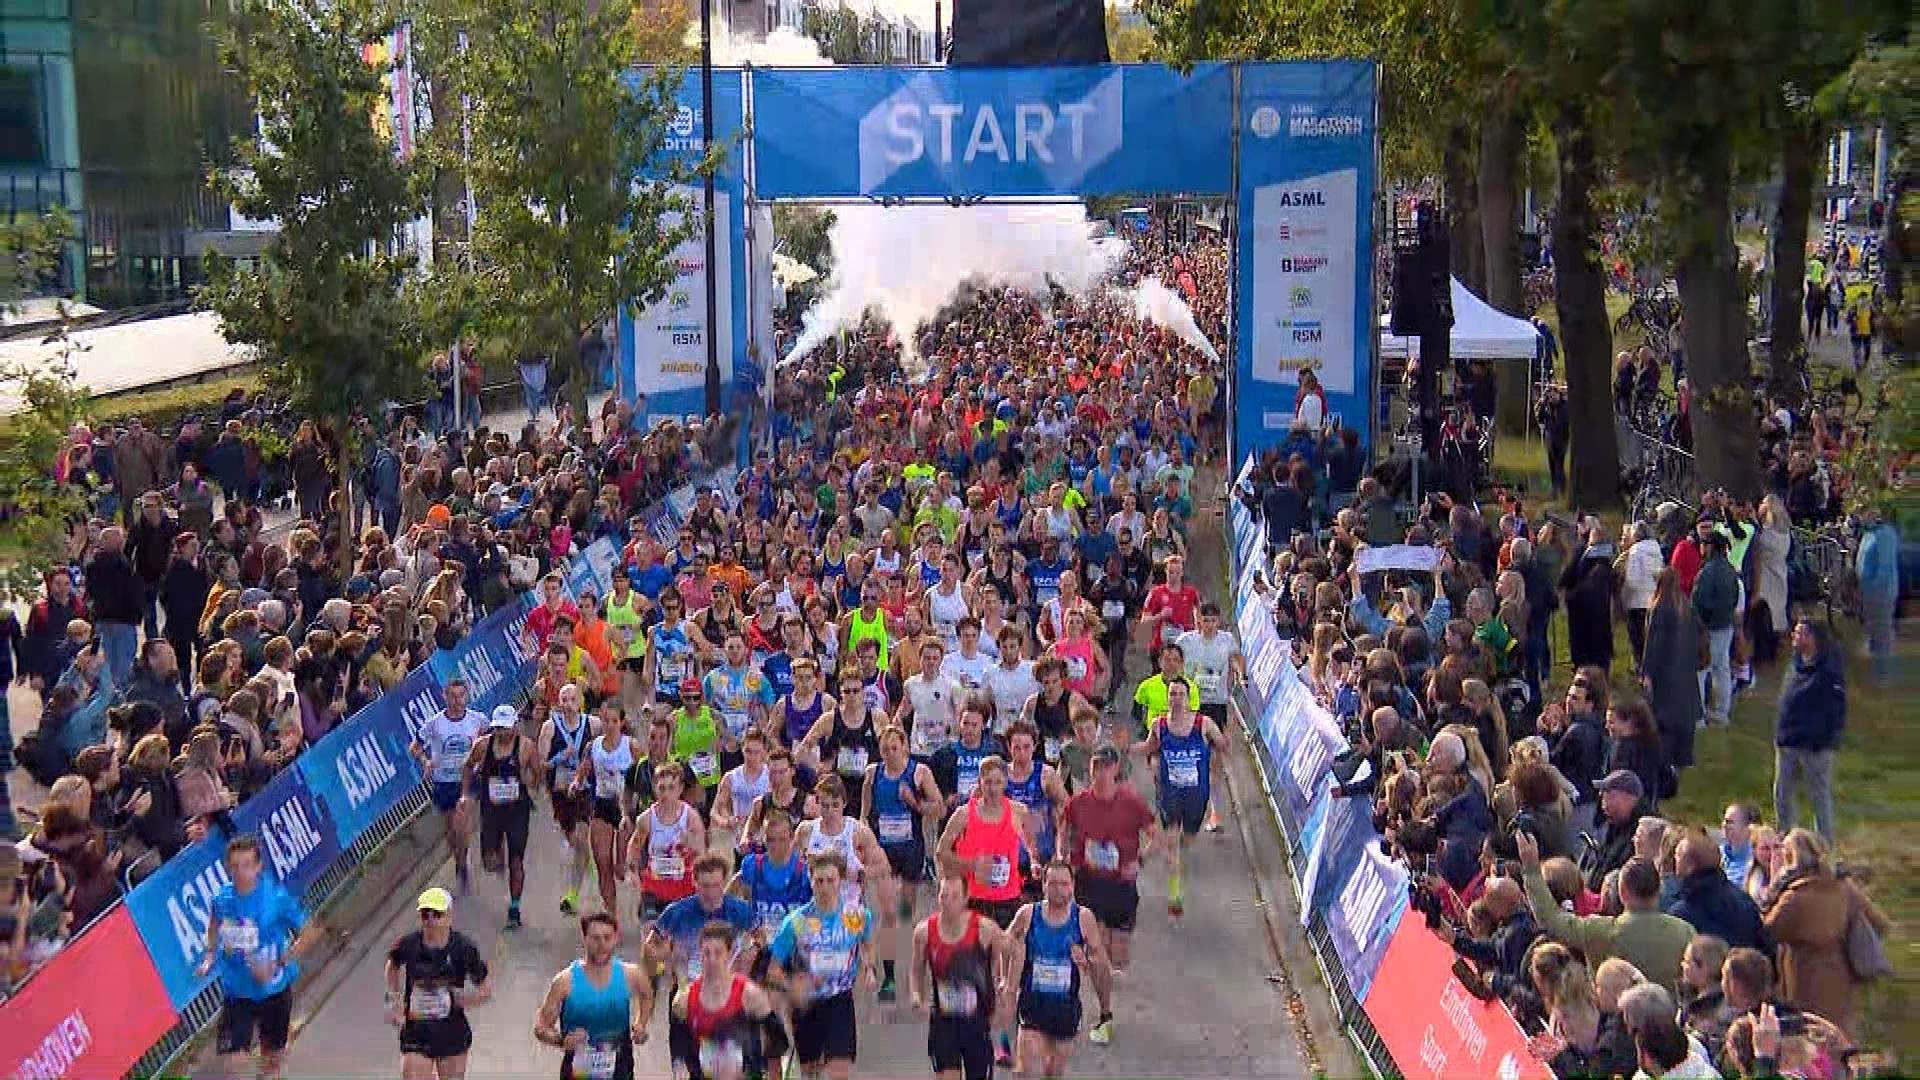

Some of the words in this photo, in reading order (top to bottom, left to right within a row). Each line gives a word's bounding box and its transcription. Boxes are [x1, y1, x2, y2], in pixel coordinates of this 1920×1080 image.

[885, 103, 1098, 165] START
[1280, 191, 1326, 207] ASML
[672, 333, 701, 345] RSM
[1292, 330, 1322, 343] RSM
[336, 732, 397, 810] ASML
[260, 795, 322, 881] ASML
